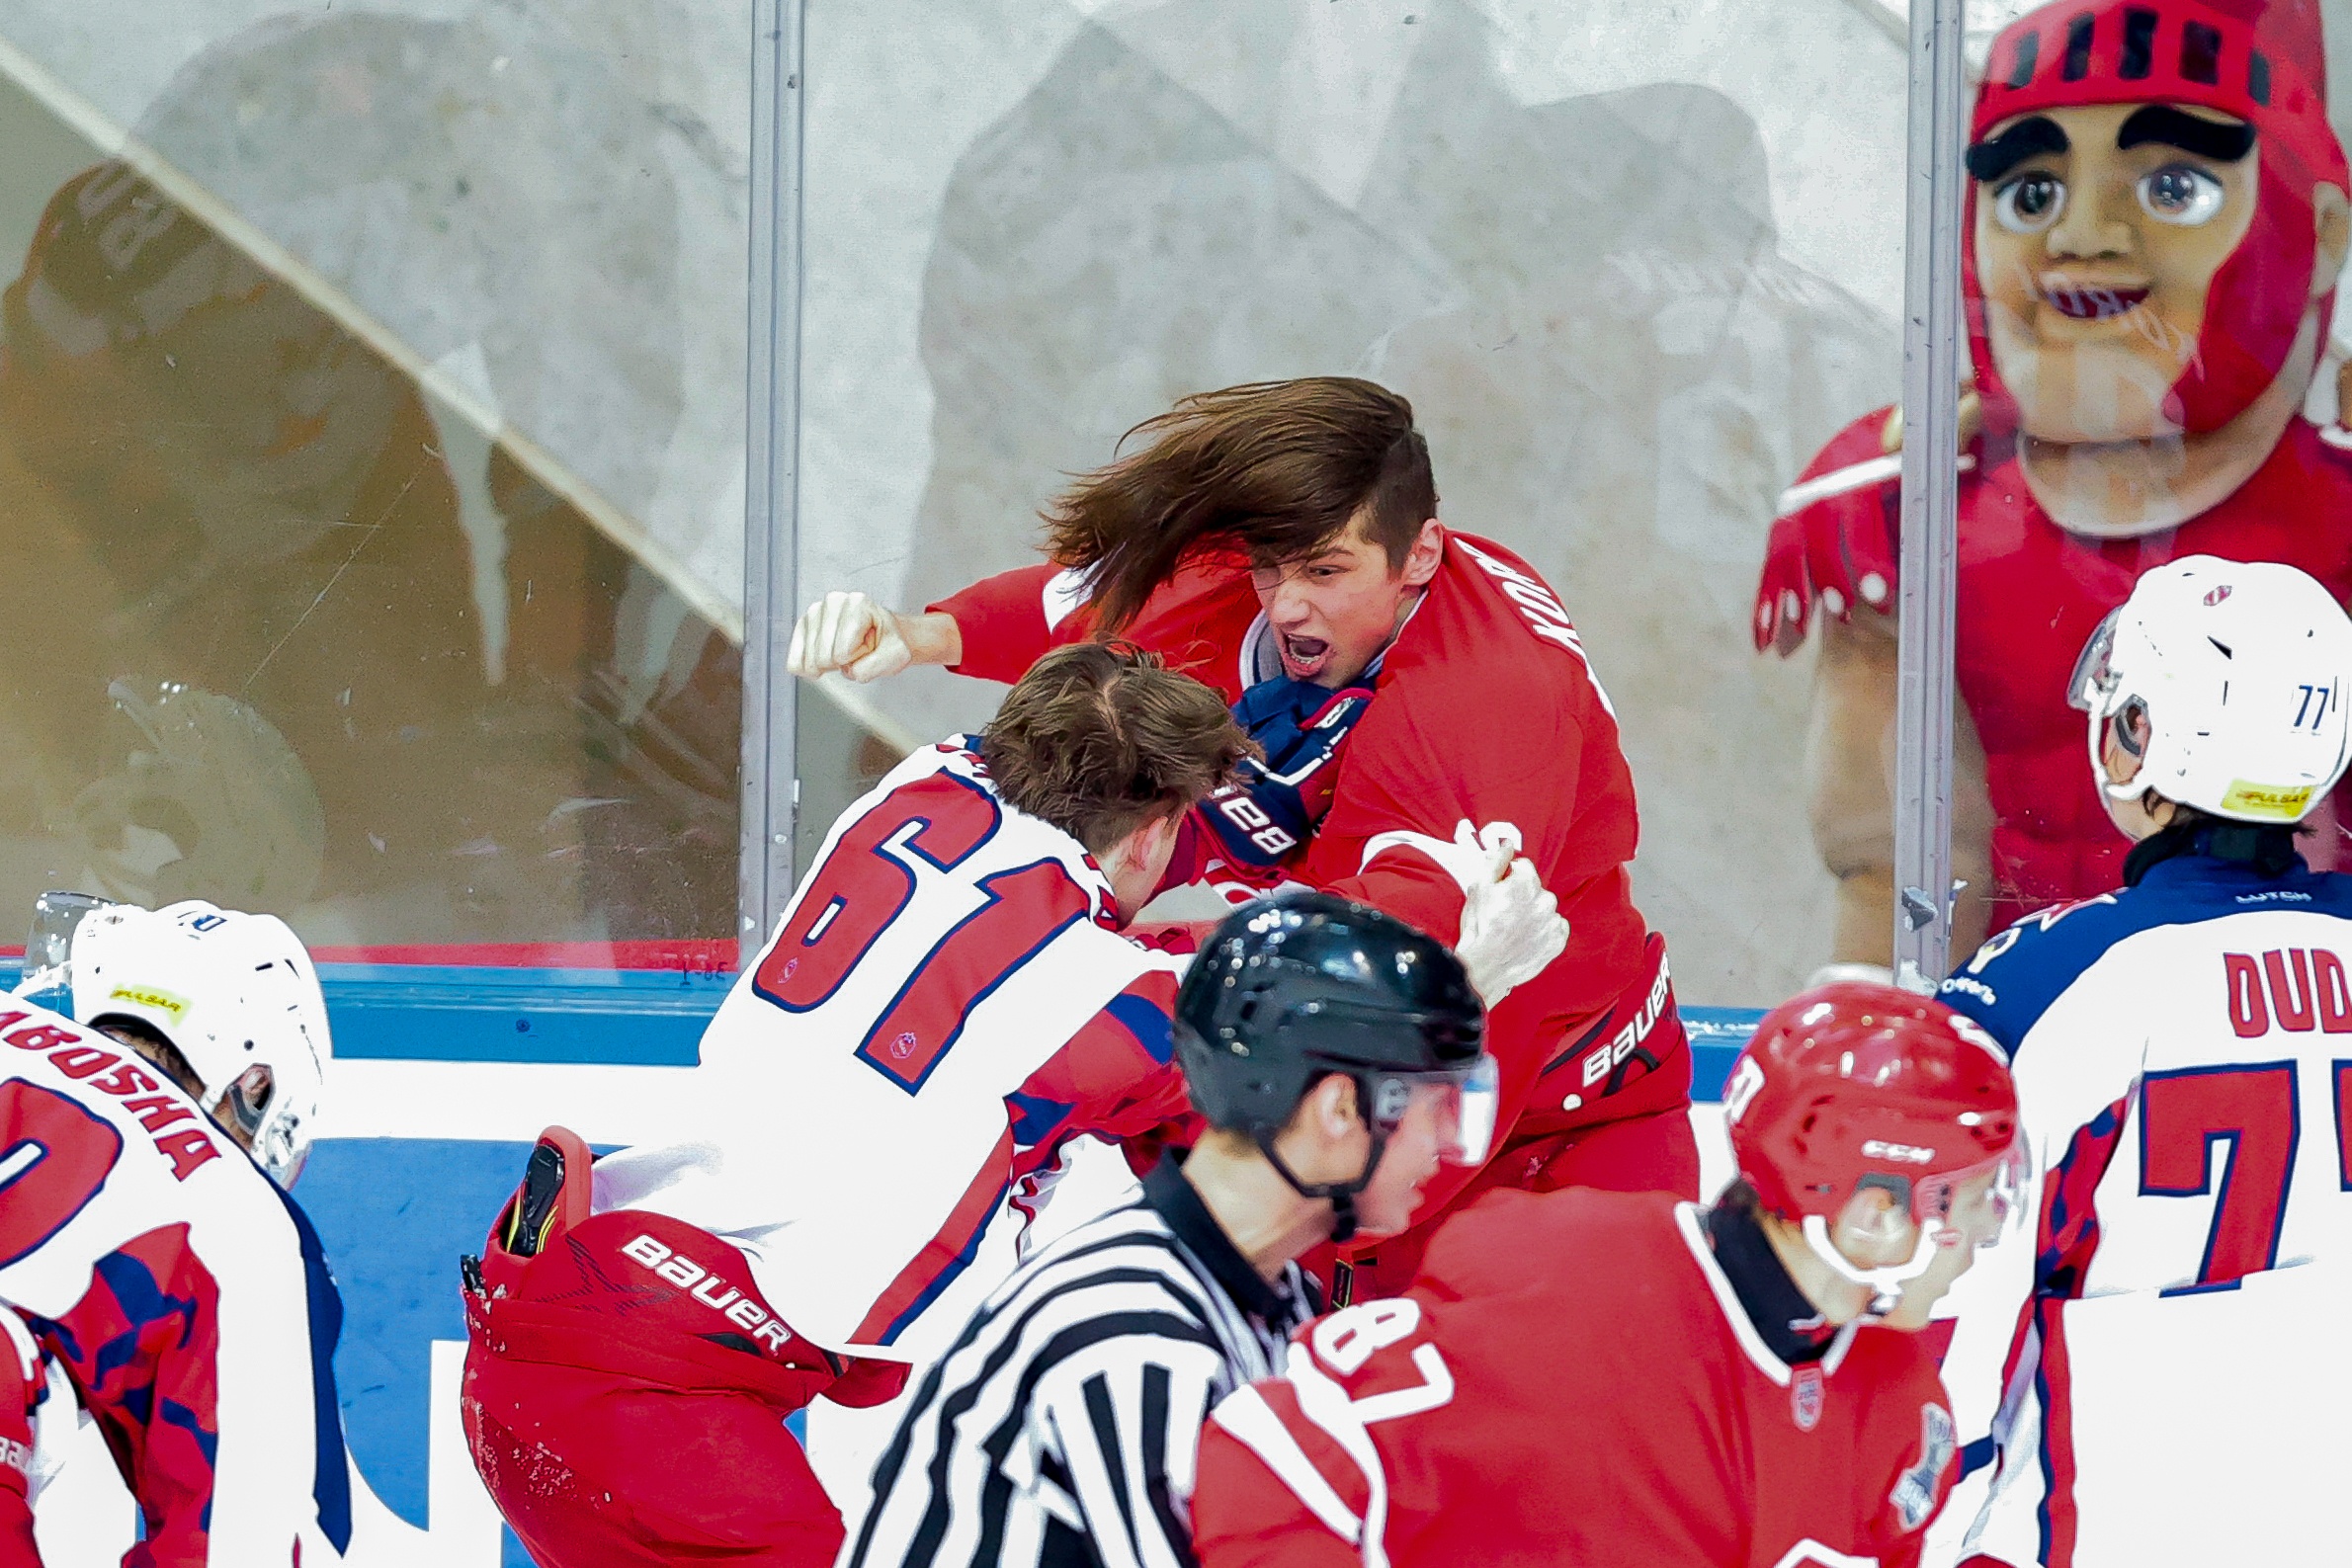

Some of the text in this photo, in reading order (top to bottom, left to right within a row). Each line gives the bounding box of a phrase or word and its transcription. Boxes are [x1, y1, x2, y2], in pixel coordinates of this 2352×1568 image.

[2293, 685, 2330, 730] 77
[751, 766, 1091, 1097] 61
[2234, 891, 2313, 904] LUTCH
[1312, 1297, 1456, 1426] 87
